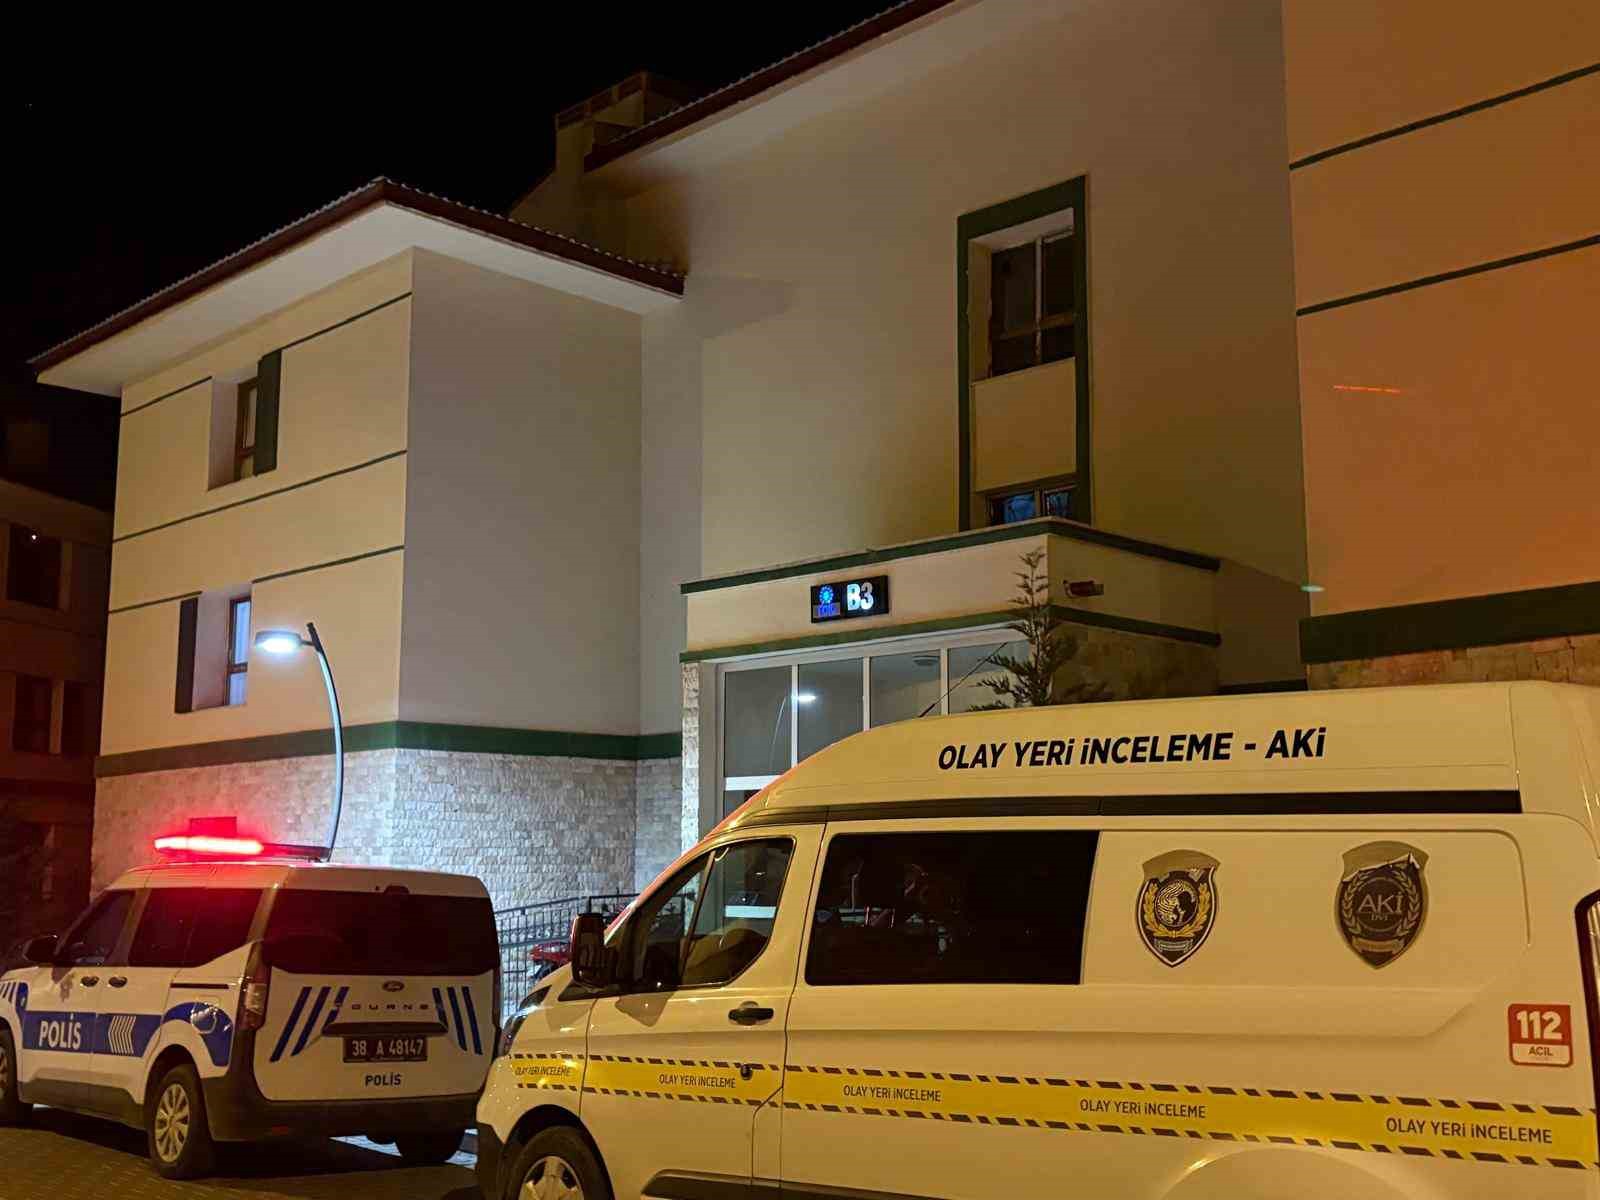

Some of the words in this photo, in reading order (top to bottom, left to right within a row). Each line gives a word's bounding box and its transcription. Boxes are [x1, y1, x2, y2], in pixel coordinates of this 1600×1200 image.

[847, 582, 874, 610] B3
[938, 743, 1008, 770] OLAY
[38, 1013, 82, 1050] POLİS
[1516, 1010, 1563, 1040] 112
[352, 1040, 367, 1056] 38
[375, 1040, 385, 1056] A
[389, 1039, 424, 1056] 48147
[659, 1073, 678, 1085] OLAY
[843, 1084, 867, 1097] OLAY
[1079, 1098, 1112, 1113] OLAY
[1386, 1117, 1426, 1134] OLAY
